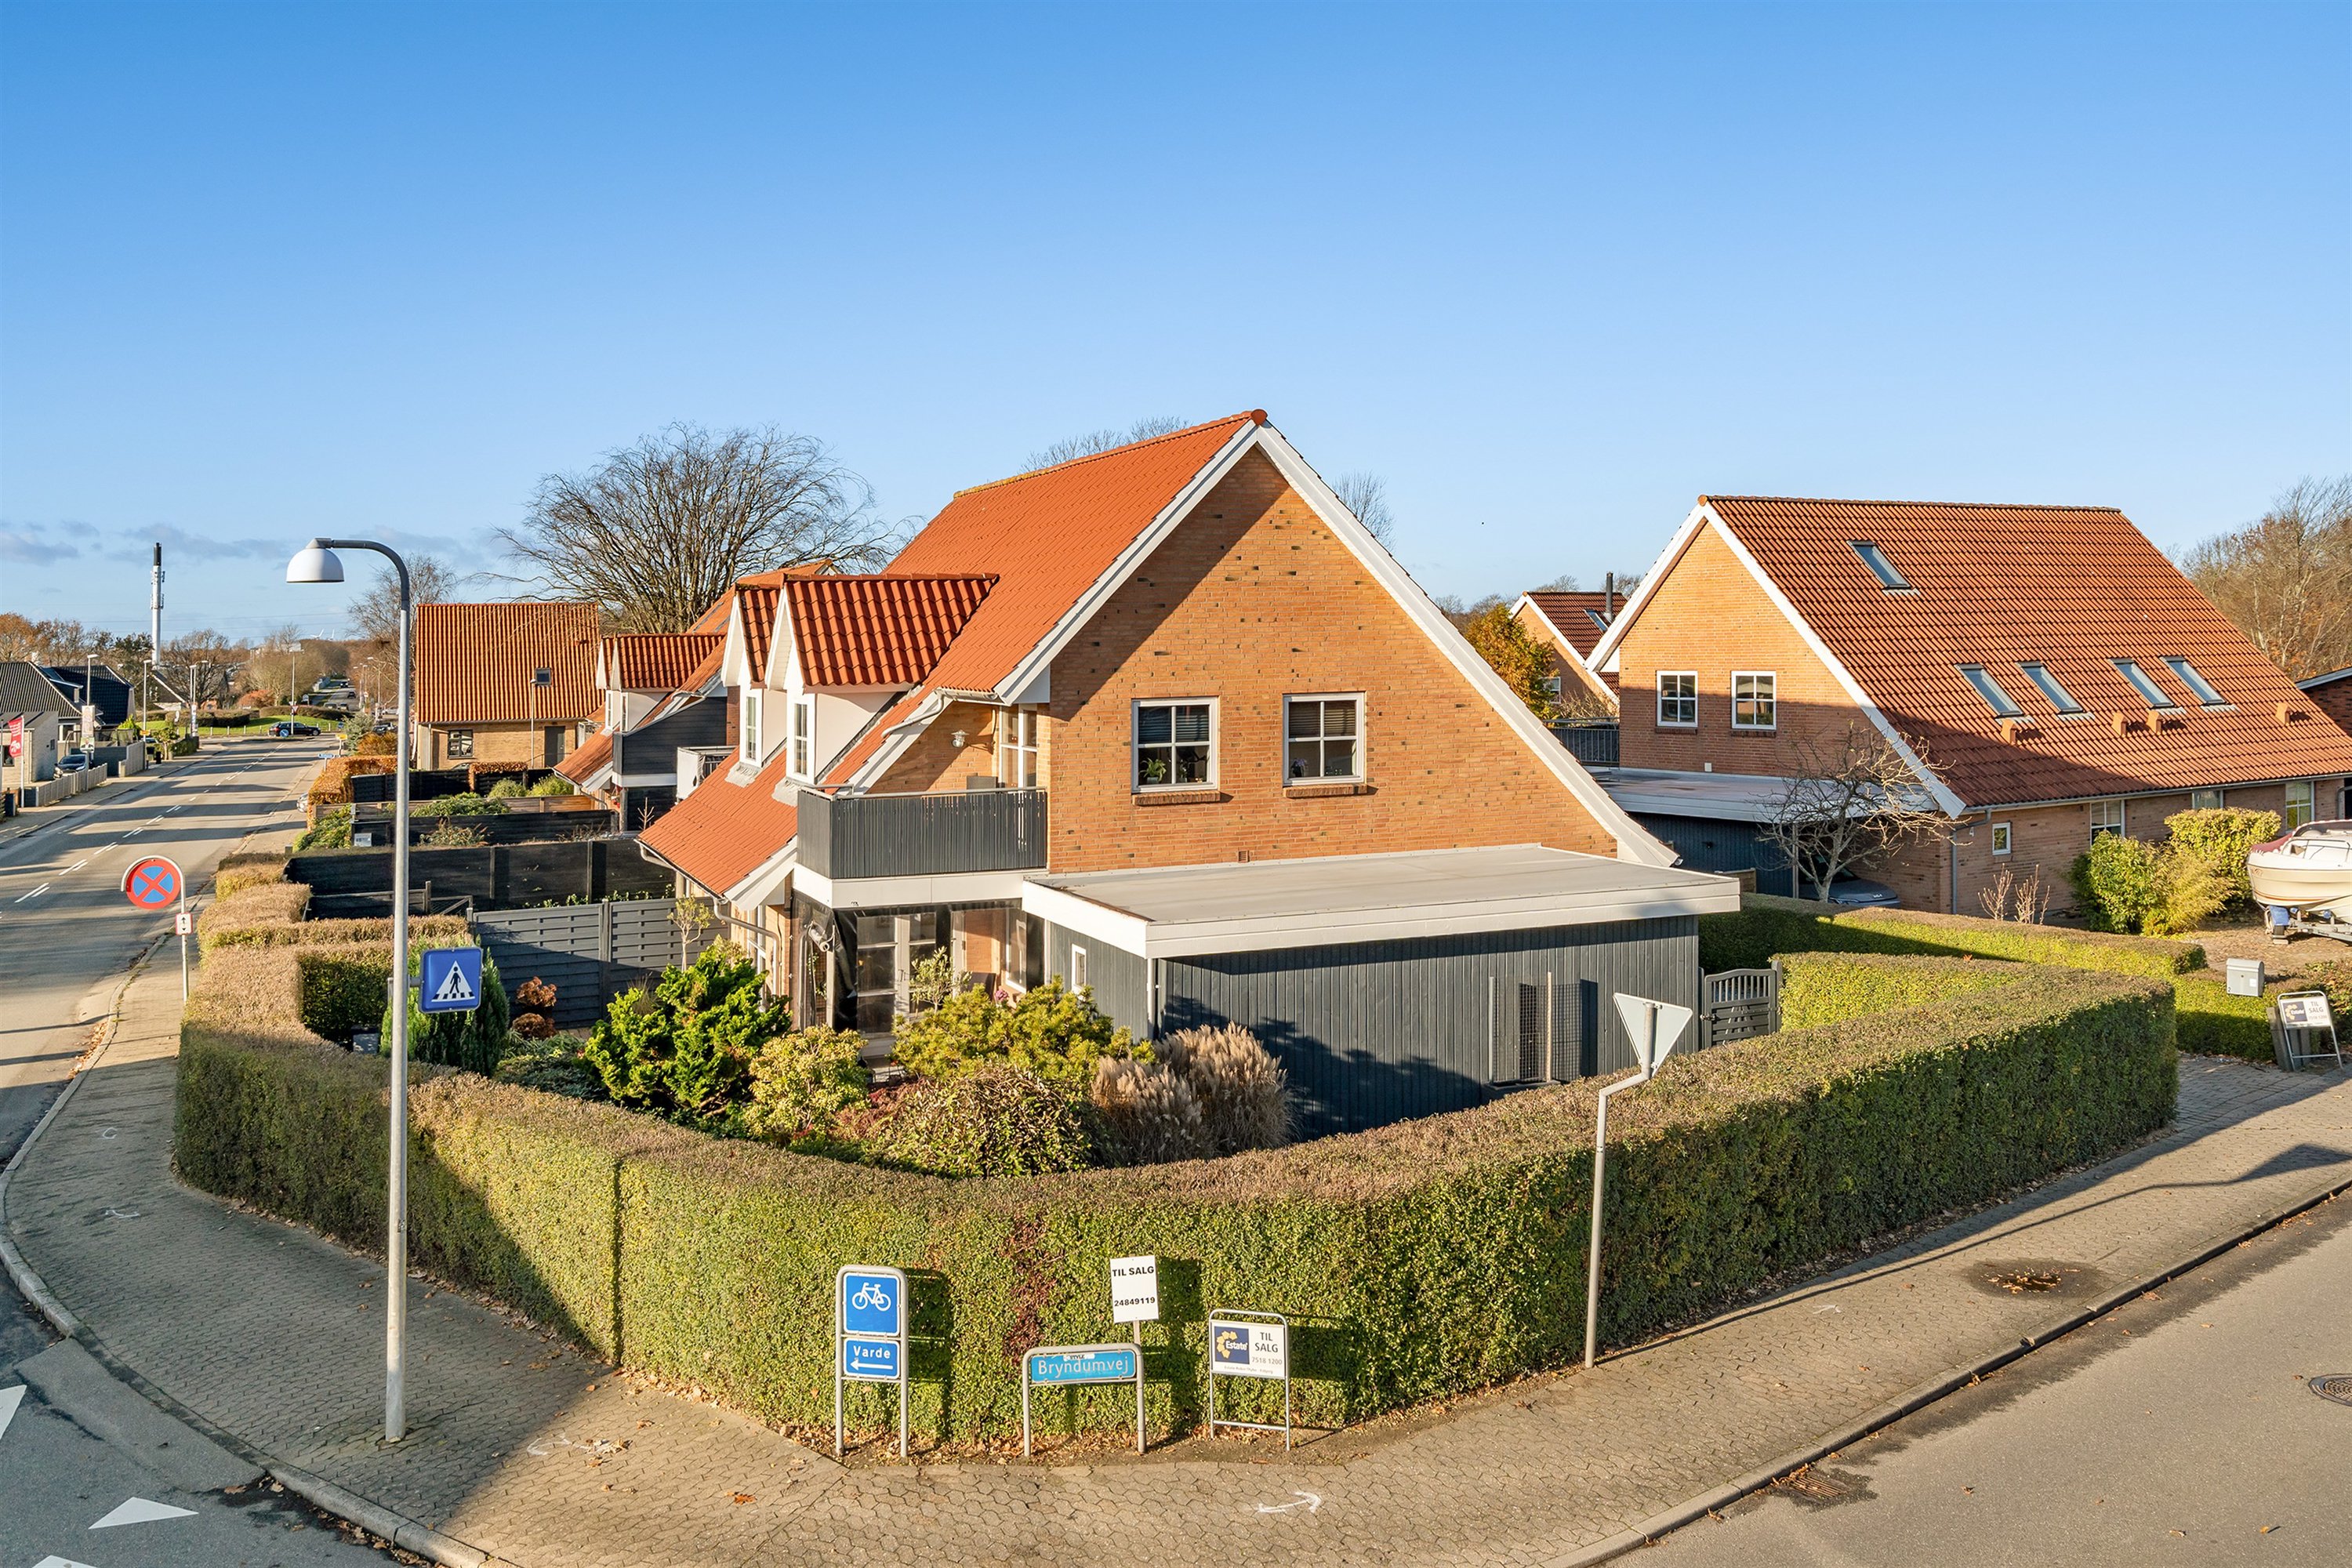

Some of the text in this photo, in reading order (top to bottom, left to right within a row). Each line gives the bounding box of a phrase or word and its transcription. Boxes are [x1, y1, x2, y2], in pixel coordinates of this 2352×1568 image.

[1128, 1265, 1154, 1276] SALG
[1114, 1296, 1156, 1307] 24849119
[1260, 1332, 1273, 1341] TIL
[1225, 1340, 1247, 1351] Estate
[1254, 1342, 1279, 1353] SALG
[853, 1345, 891, 1359] Varde
[1038, 1356, 1129, 1379] Bryndumvej
